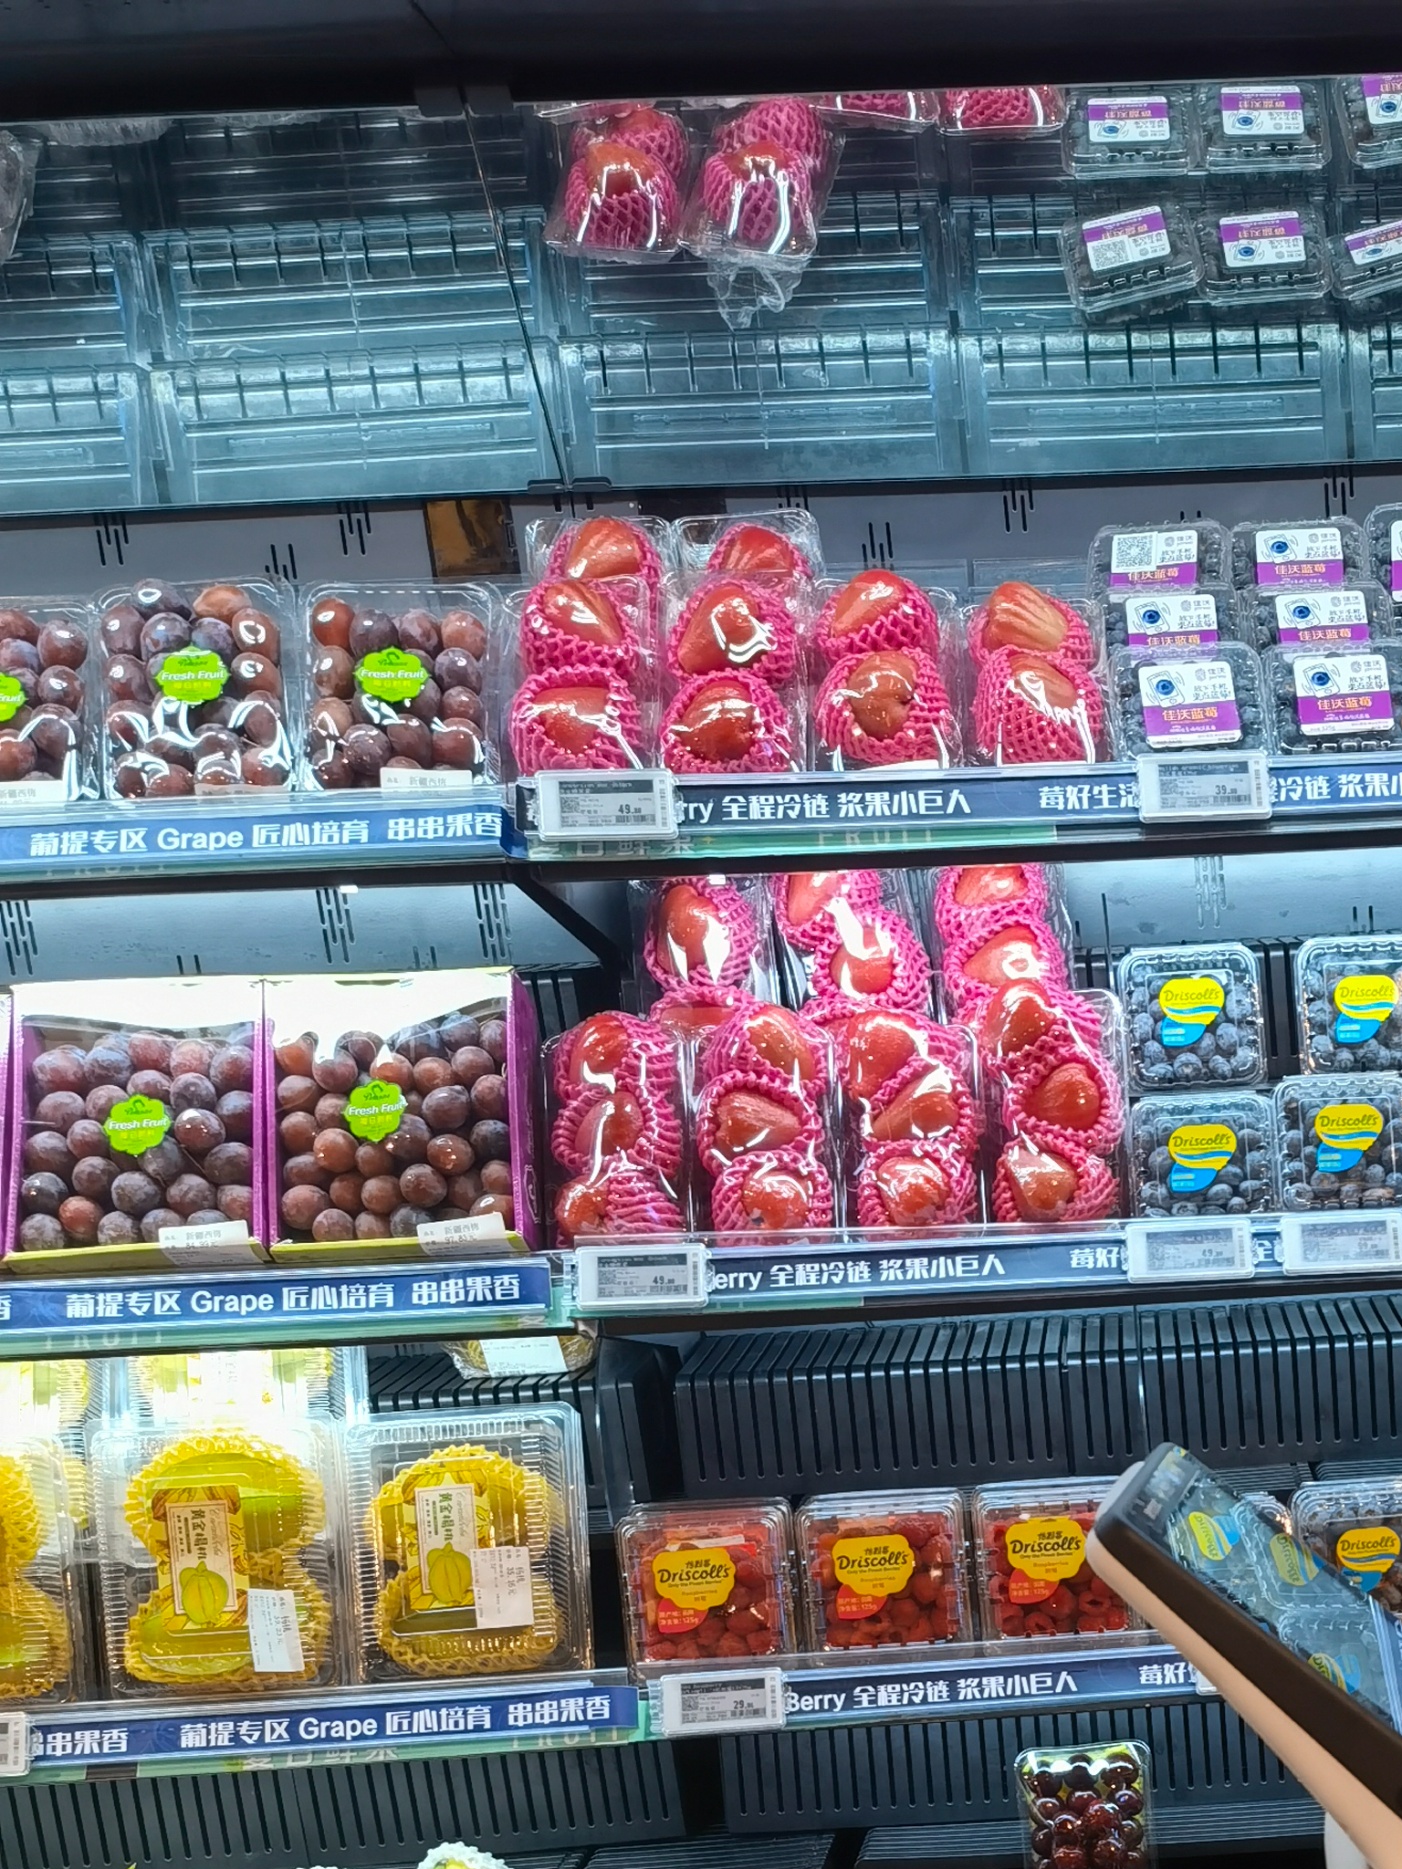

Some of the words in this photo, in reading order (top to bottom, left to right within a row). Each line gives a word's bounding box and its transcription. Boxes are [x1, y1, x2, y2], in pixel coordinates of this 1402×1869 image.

[161, 670, 195, 682] Fresh
[197, 668, 225, 680] Fruit
[360, 669, 394, 681] Fresh
[397, 669, 424, 681] Fruit
[1270, 774, 1331, 802] 冷链
[676, 799, 716, 827] rry
[721, 795, 831, 821] 全程冷链
[838, 789, 971, 818] 浆果小巨人
[157, 825, 243, 852] Grape
[252, 819, 370, 847] 匠心培育
[387, 812, 502, 842] 串串果香
[1164, 987, 1221, 1002] Driscoll's
[1339, 986, 1396, 1000] Driscoll's
[348, 1106, 377, 1119] Fresh
[1319, 1114, 1379, 1129] Driscoll's
[106, 1119, 139, 1133] Fresh
[141, 1117, 169, 1130] Fruit
[1172, 1134, 1230, 1149] Driscoll's
[710, 1264, 762, 1292] erry
[769, 1260, 872, 1285] 全程冷链
[879, 1252, 1006, 1280] 浆果小巨人
[190, 1290, 274, 1317] Grape
[282, 1283, 395, 1311] 匠心培育
[412, 1274, 520, 1304] 串串果香
[1010, 1536, 1082, 1555] Driscoll's
[1341, 1534, 1397, 1552] Driscoll's
[836, 1551, 909, 1571] Driscoll's
[657, 1563, 731, 1584] Driscoll's
[787, 1688, 846, 1714] Berry
[853, 1681, 949, 1708] 全程冷链
[957, 1671, 1078, 1700] 浆果小巨人
[299, 1715, 378, 1742] Grape
[386, 1706, 492, 1735] 匠心培育
[507, 1696, 611, 1727] 串串果香
